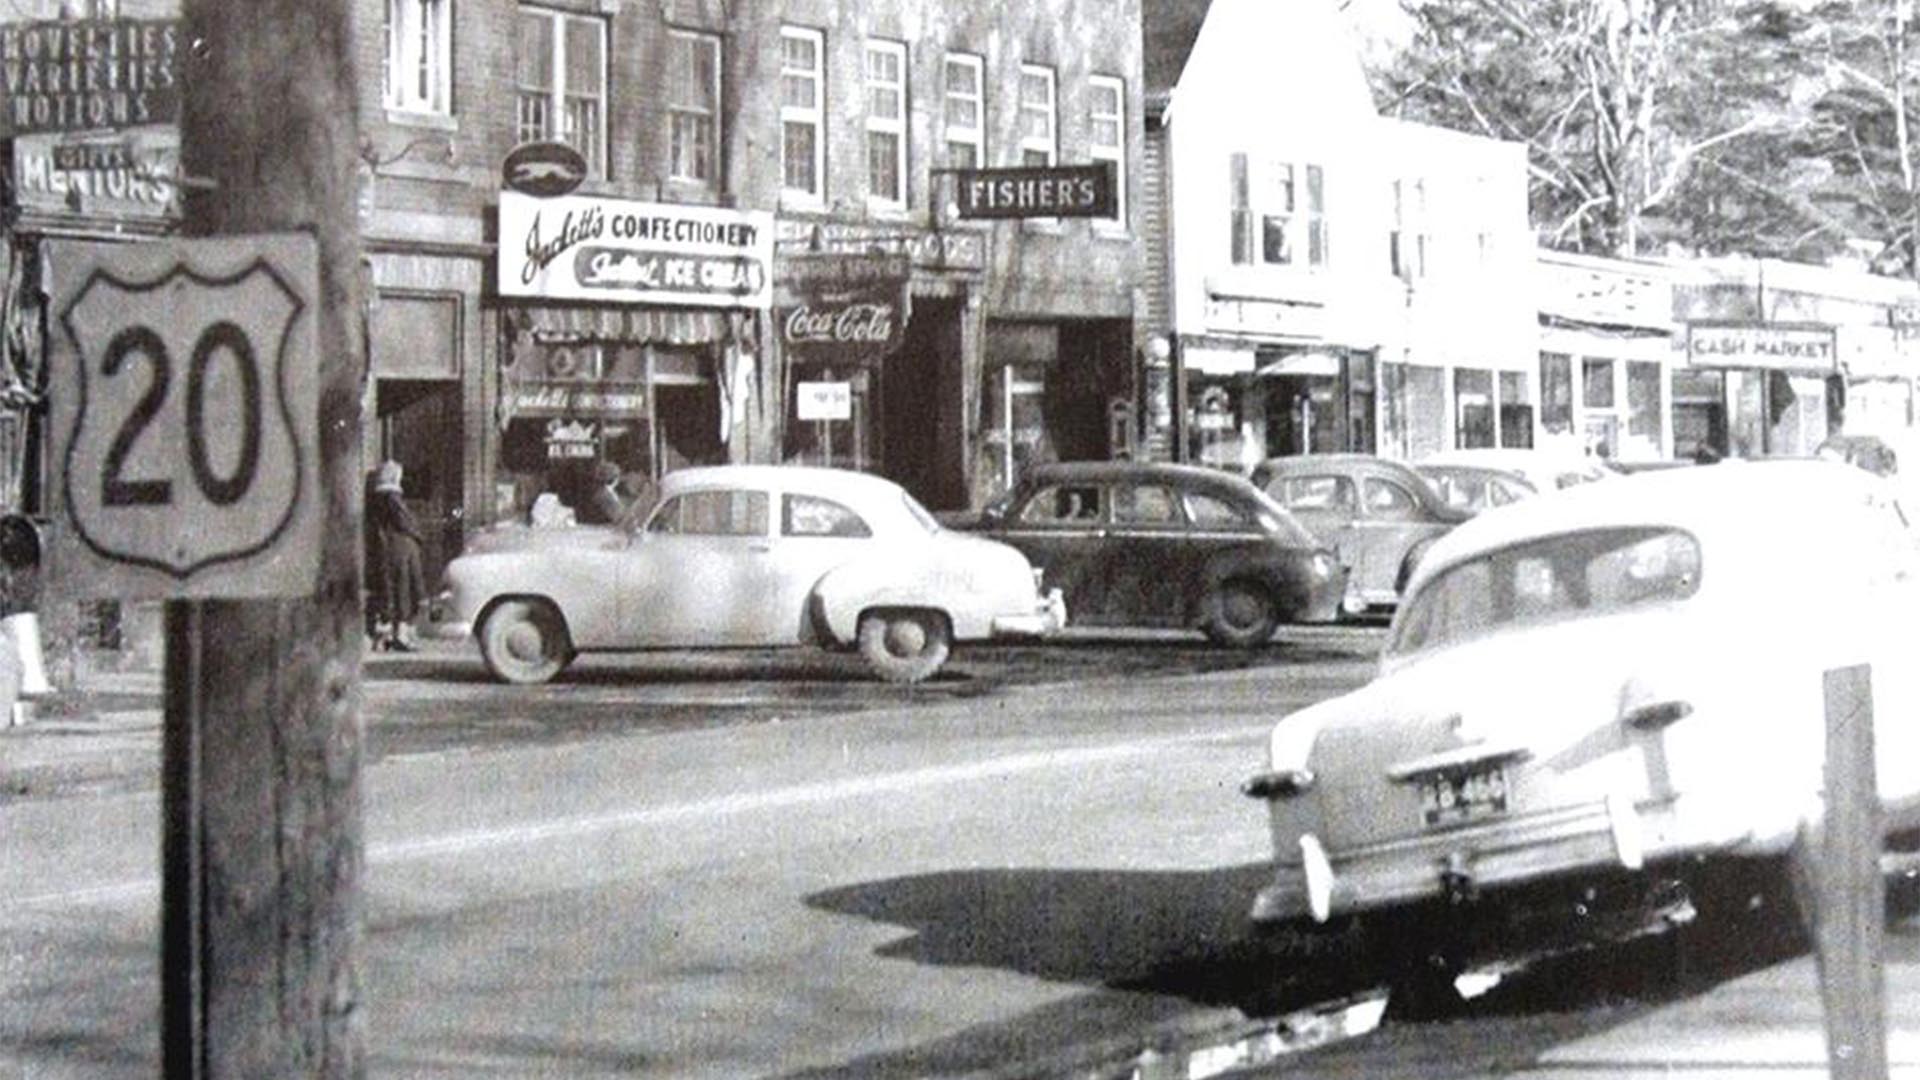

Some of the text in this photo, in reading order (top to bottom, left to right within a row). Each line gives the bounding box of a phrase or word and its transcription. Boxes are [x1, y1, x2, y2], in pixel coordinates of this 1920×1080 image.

[4, 26, 176, 59] NOVELTIES
[5, 60, 174, 92] VARIETIES
[15, 92, 149, 126] NOTIONS
[971, 177, 1095, 208] FISHER'S
[611, 214, 758, 247] CONFECTIONERY
[665, 259, 696, 286] ICE
[1693, 338, 1831, 358] CASH MARKET
[102, 321, 262, 506] 20
